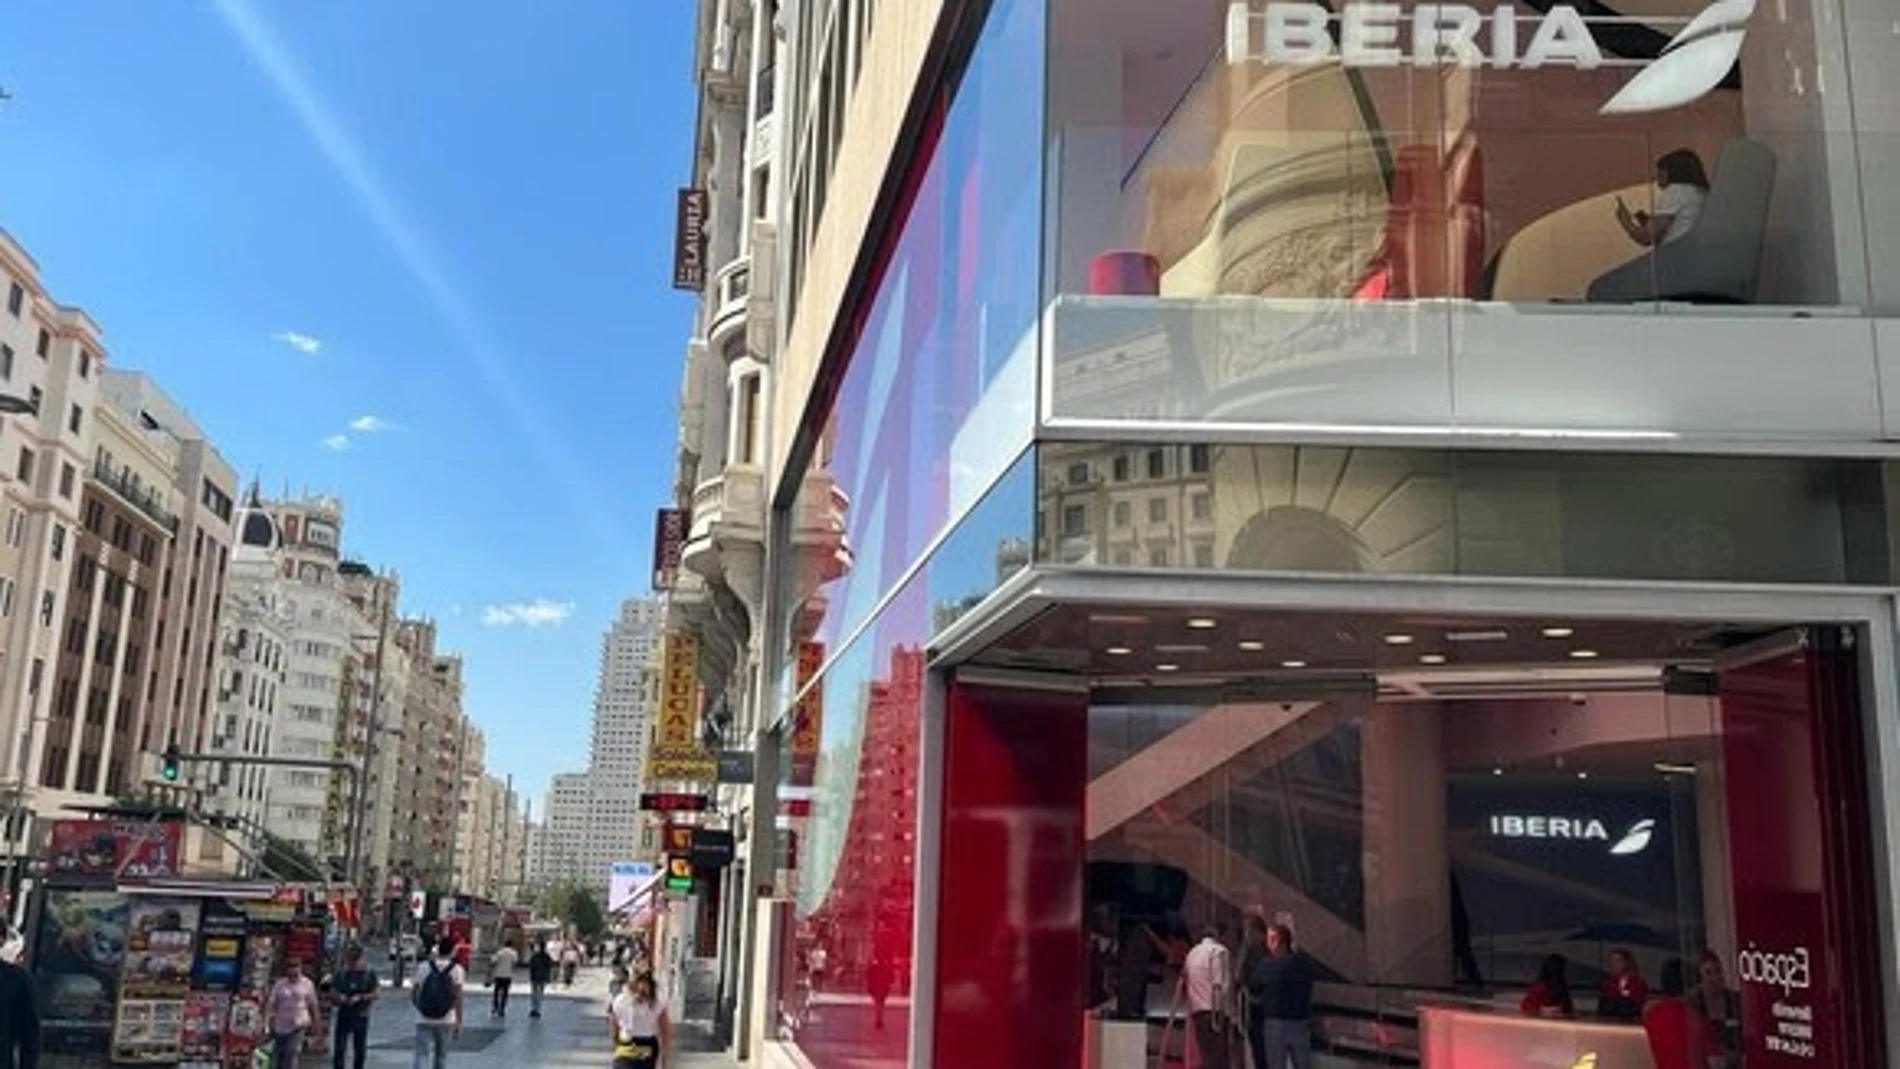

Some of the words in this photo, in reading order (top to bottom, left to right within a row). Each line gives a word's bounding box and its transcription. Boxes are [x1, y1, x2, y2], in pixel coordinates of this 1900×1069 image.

[1226, 2, 1601, 68] IBERIA
[684, 194, 703, 265] LAURIA
[1490, 815, 1608, 840] IBERIA
